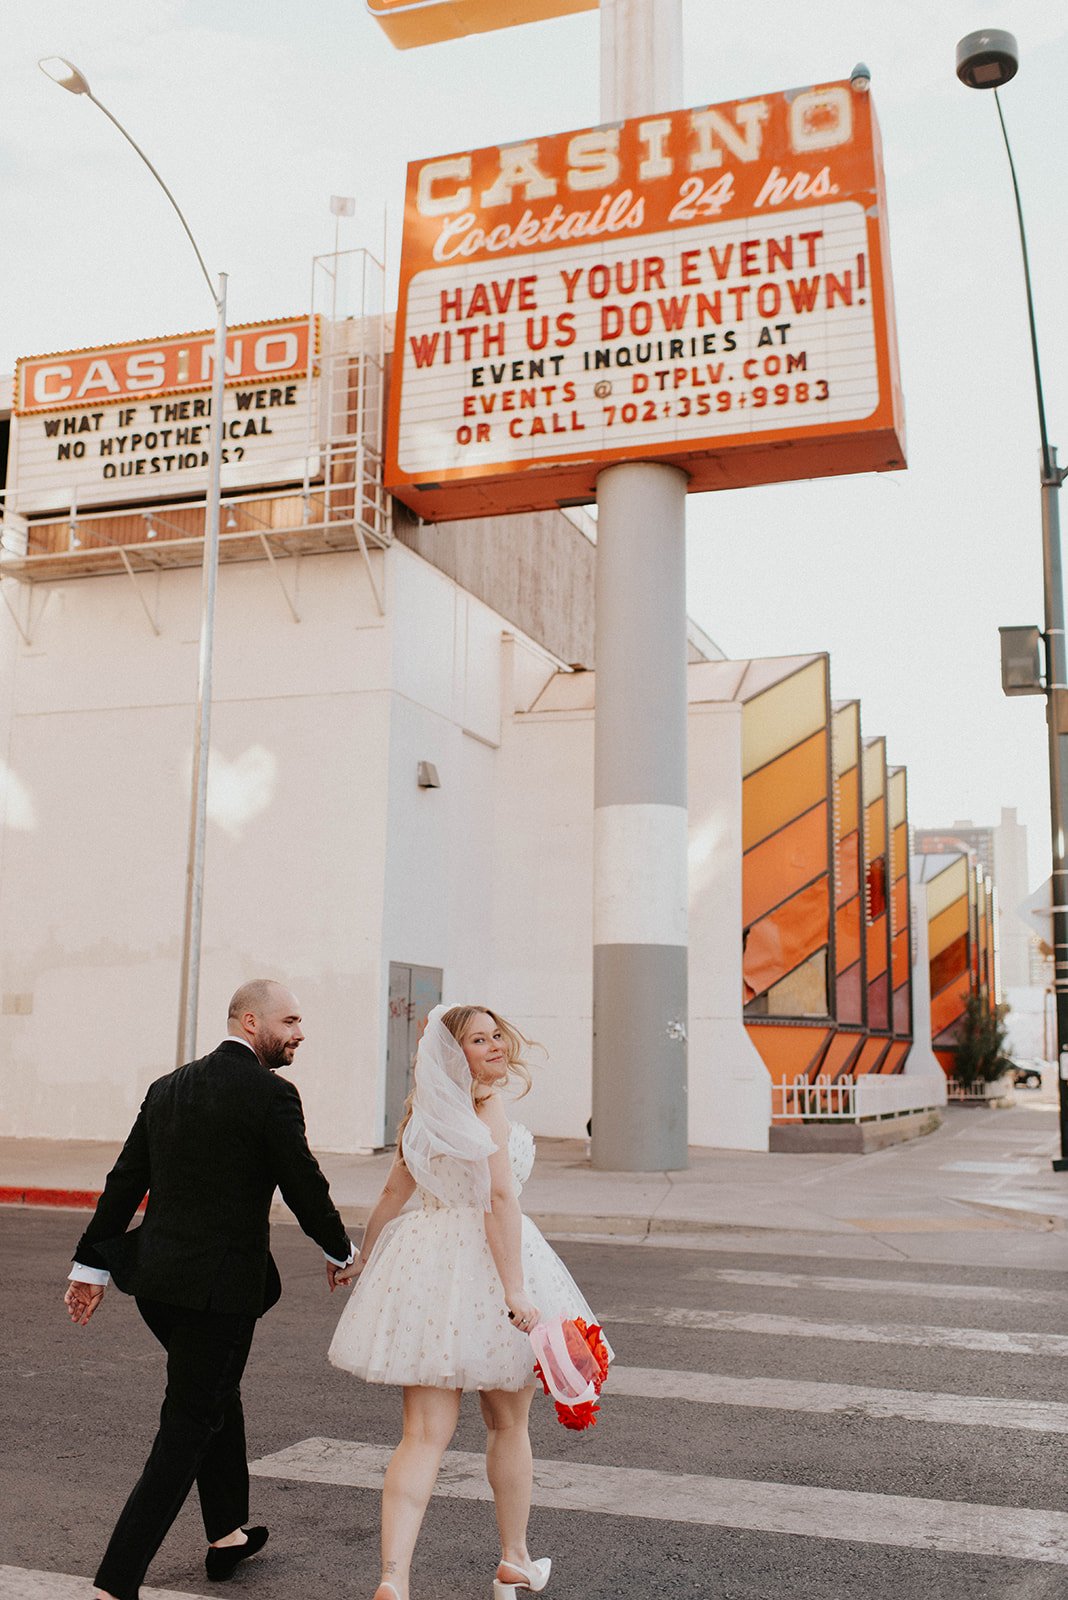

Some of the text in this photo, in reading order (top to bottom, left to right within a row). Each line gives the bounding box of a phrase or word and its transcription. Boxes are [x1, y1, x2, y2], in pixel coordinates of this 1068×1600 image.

[416, 86, 853, 217] CASINO
[432, 166, 839, 263] Cocktails 24 hrs.
[409, 253, 868, 368] WITH US DOWNTOWN!
[440, 231, 824, 323] HAVE YOUR EVENT
[33, 332, 298, 403] CASINO
[471, 323, 791, 388] EVENT INQUIRIES AT
[44, 413, 104, 438] WHAT
[118, 408, 138, 428] IF
[235, 385, 297, 412] WERE
[456, 422, 491, 445] OR
[509, 410, 586, 439] CALL
[463, 380, 577, 417] EVENTS
[594, 380, 613, 399] @
[57, 440, 86, 461] NO
